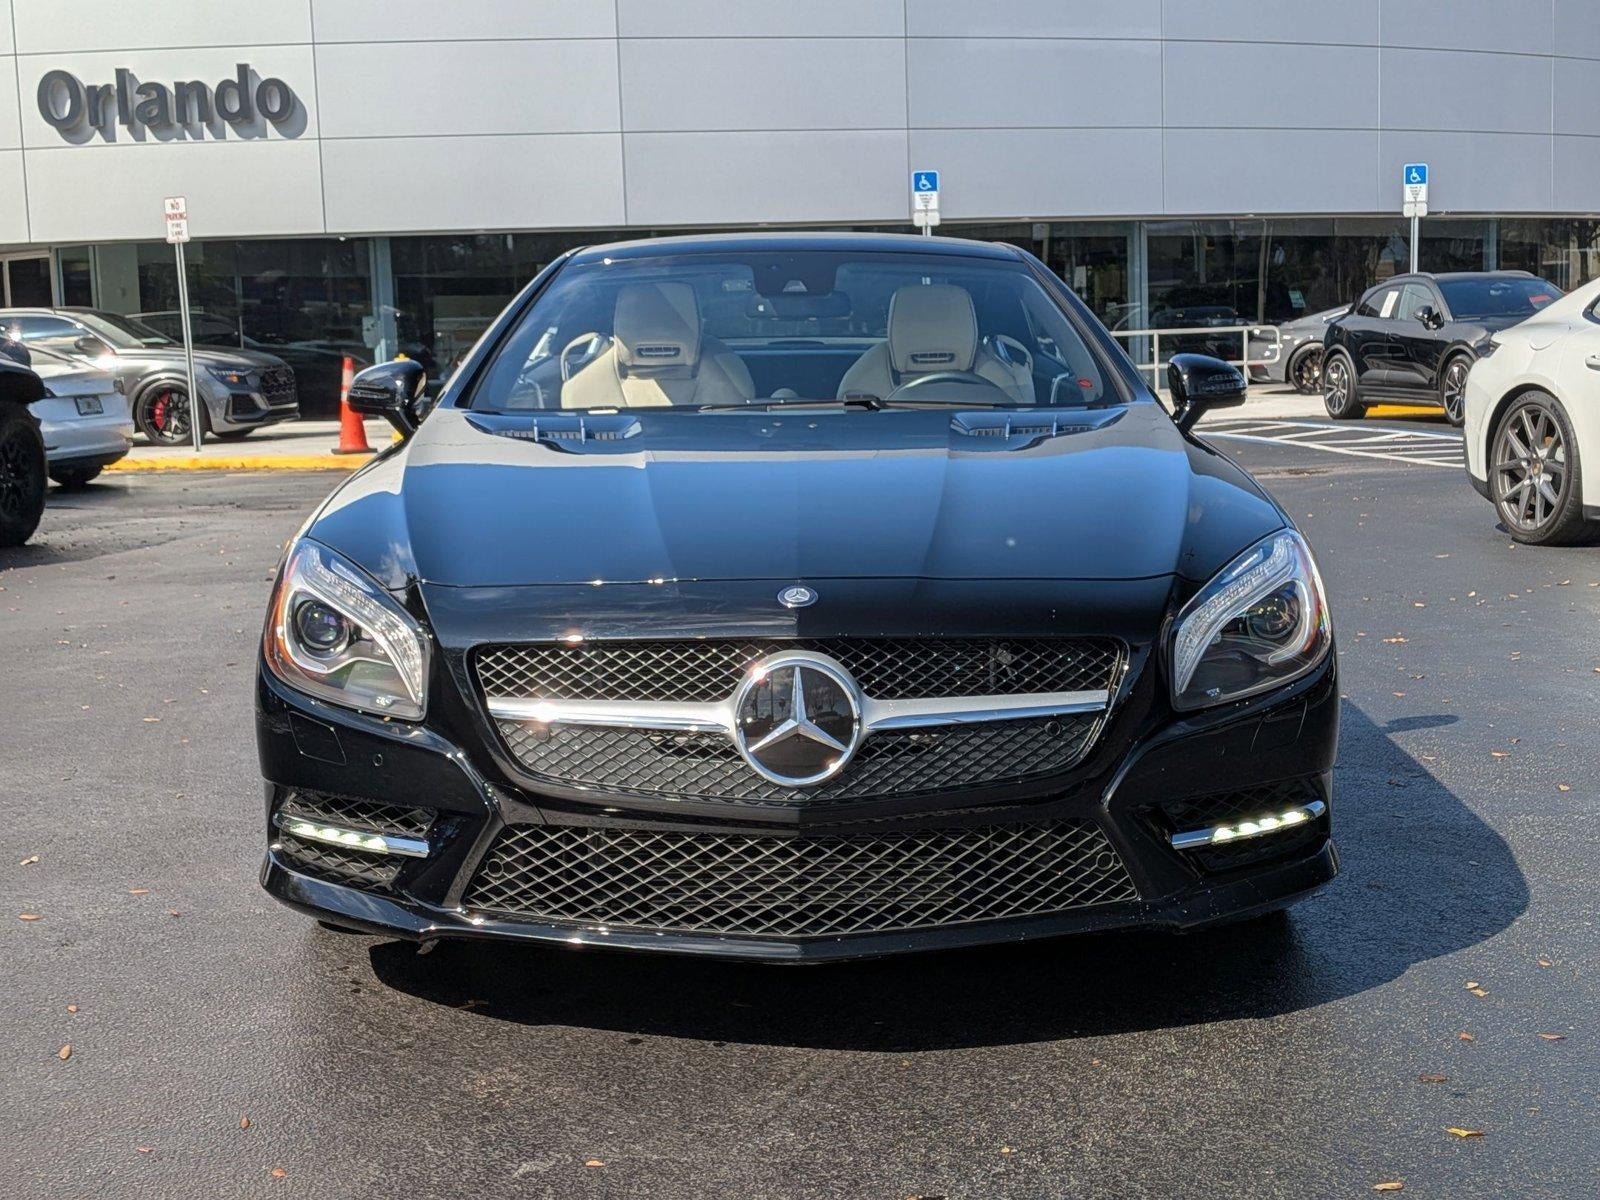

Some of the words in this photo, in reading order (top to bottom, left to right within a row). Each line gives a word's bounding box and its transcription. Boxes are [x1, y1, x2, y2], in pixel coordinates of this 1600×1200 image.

[37, 63, 292, 129] Orlando
[170, 201, 180, 210] NO
[165, 212, 187, 221] PARKING
